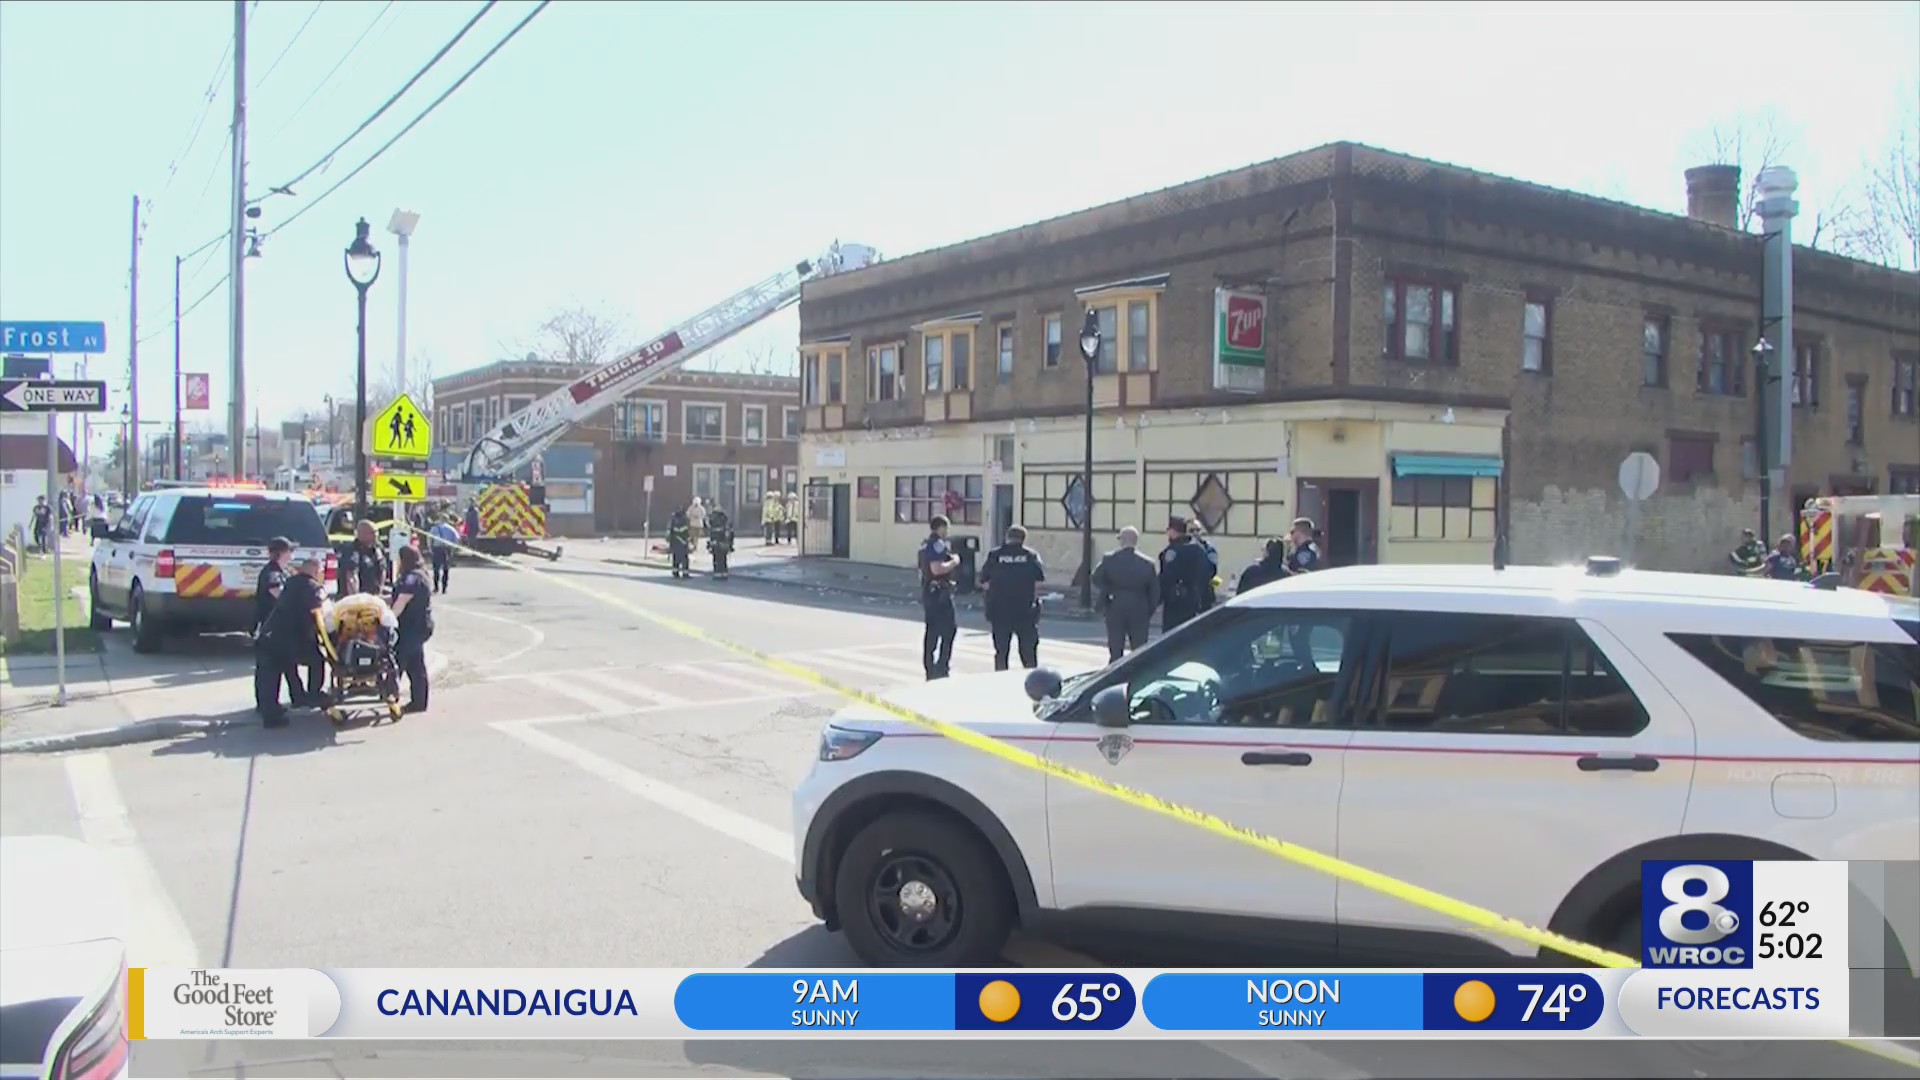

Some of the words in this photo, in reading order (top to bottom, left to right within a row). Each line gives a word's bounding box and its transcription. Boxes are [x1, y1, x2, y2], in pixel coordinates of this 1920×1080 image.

[4, 327, 69, 347] Frost
[83, 336, 97, 346] AV
[585, 354, 642, 388] TRUCK
[645, 341, 664, 356] 10
[24, 389, 55, 402] ONE
[63, 389, 95, 402] WAY
[998, 555, 1028, 564] POLICE
